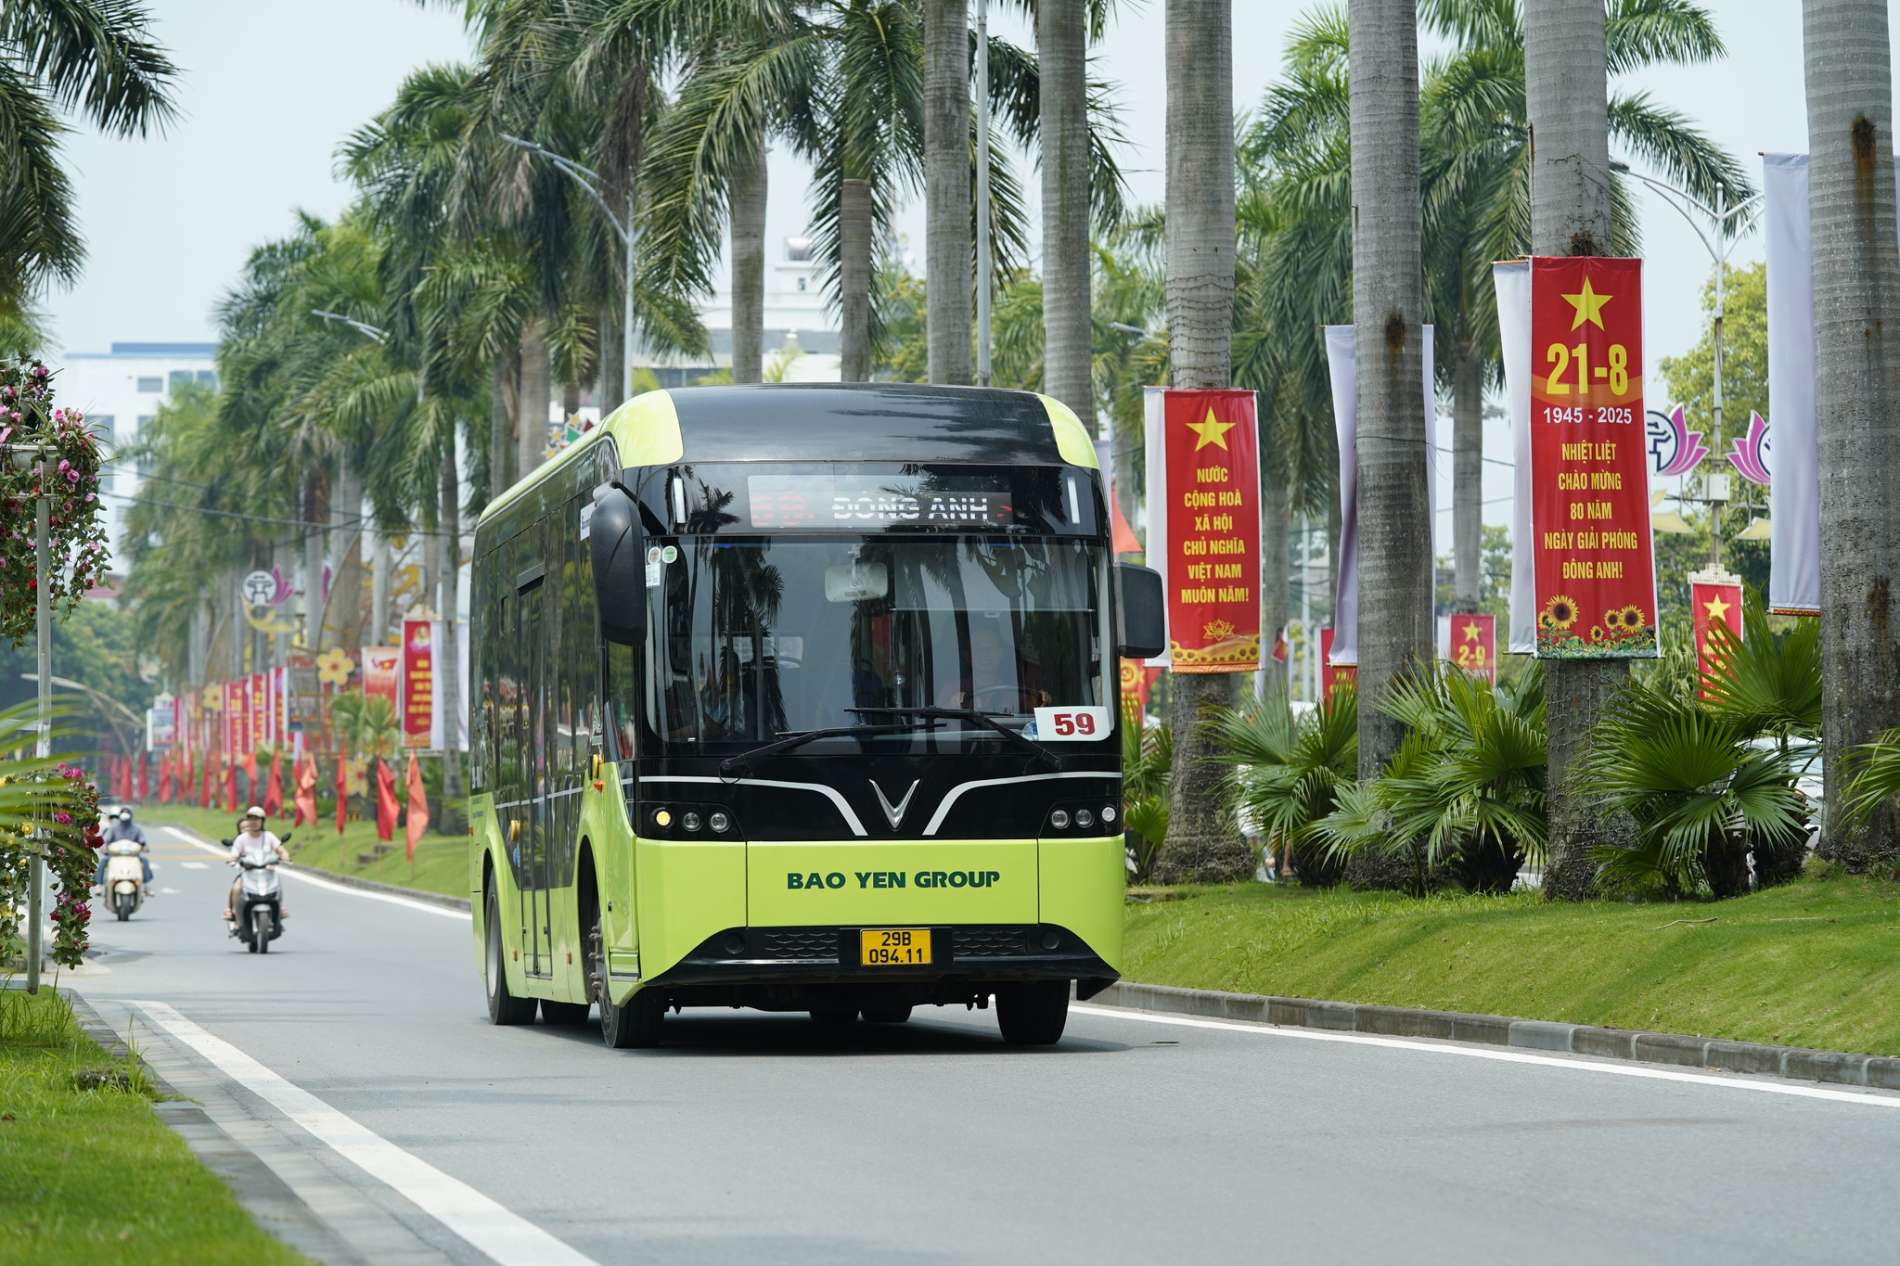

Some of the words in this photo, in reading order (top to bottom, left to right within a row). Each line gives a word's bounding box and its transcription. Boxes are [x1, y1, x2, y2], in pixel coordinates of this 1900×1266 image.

[1545, 342, 1629, 397] 21-8
[1544, 407, 1583, 424] 1945
[1598, 406, 1632, 425] 2025
[1561, 441, 1594, 465] NHIỆT
[1595, 440, 1617, 463] LIỆT
[1196, 464, 1229, 483] NƯỚC
[1558, 470, 1588, 491] CHÀO
[1590, 469, 1622, 491] MỪNG
[928, 497, 988, 520] ANH
[1184, 489, 1216, 510] CỘNG
[1218, 488, 1243, 507] HOÀ
[1570, 502, 1584, 520] 80
[1587, 499, 1612, 520] NĂM
[1194, 513, 1211, 532] XÃ
[1212, 513, 1233, 534] HỘI
[1183, 536, 1207, 556] CHỦ
[1209, 536, 1246, 556] NGHĨA
[1544, 530, 1574, 551] NGÀY
[1577, 530, 1599, 550] GIẢI
[1601, 528, 1638, 550] PHÓNG
[1187, 562, 1213, 582] VIỆT
[1214, 563, 1242, 580] NAM
[1562, 559, 1594, 580] ĐÔNG
[1595, 560, 1623, 579] ANH!
[1180, 586, 1216, 604] MUÔN
[1218, 585, 1249, 603] NĂM!
[1054, 713, 1095, 736] 59
[787, 872, 846, 889] BAO
[854, 872, 906, 888] YEN
[914, 871, 1000, 888] GROUP
[881, 931, 911, 946] 29B
[869, 948, 923, 964] 094.11
